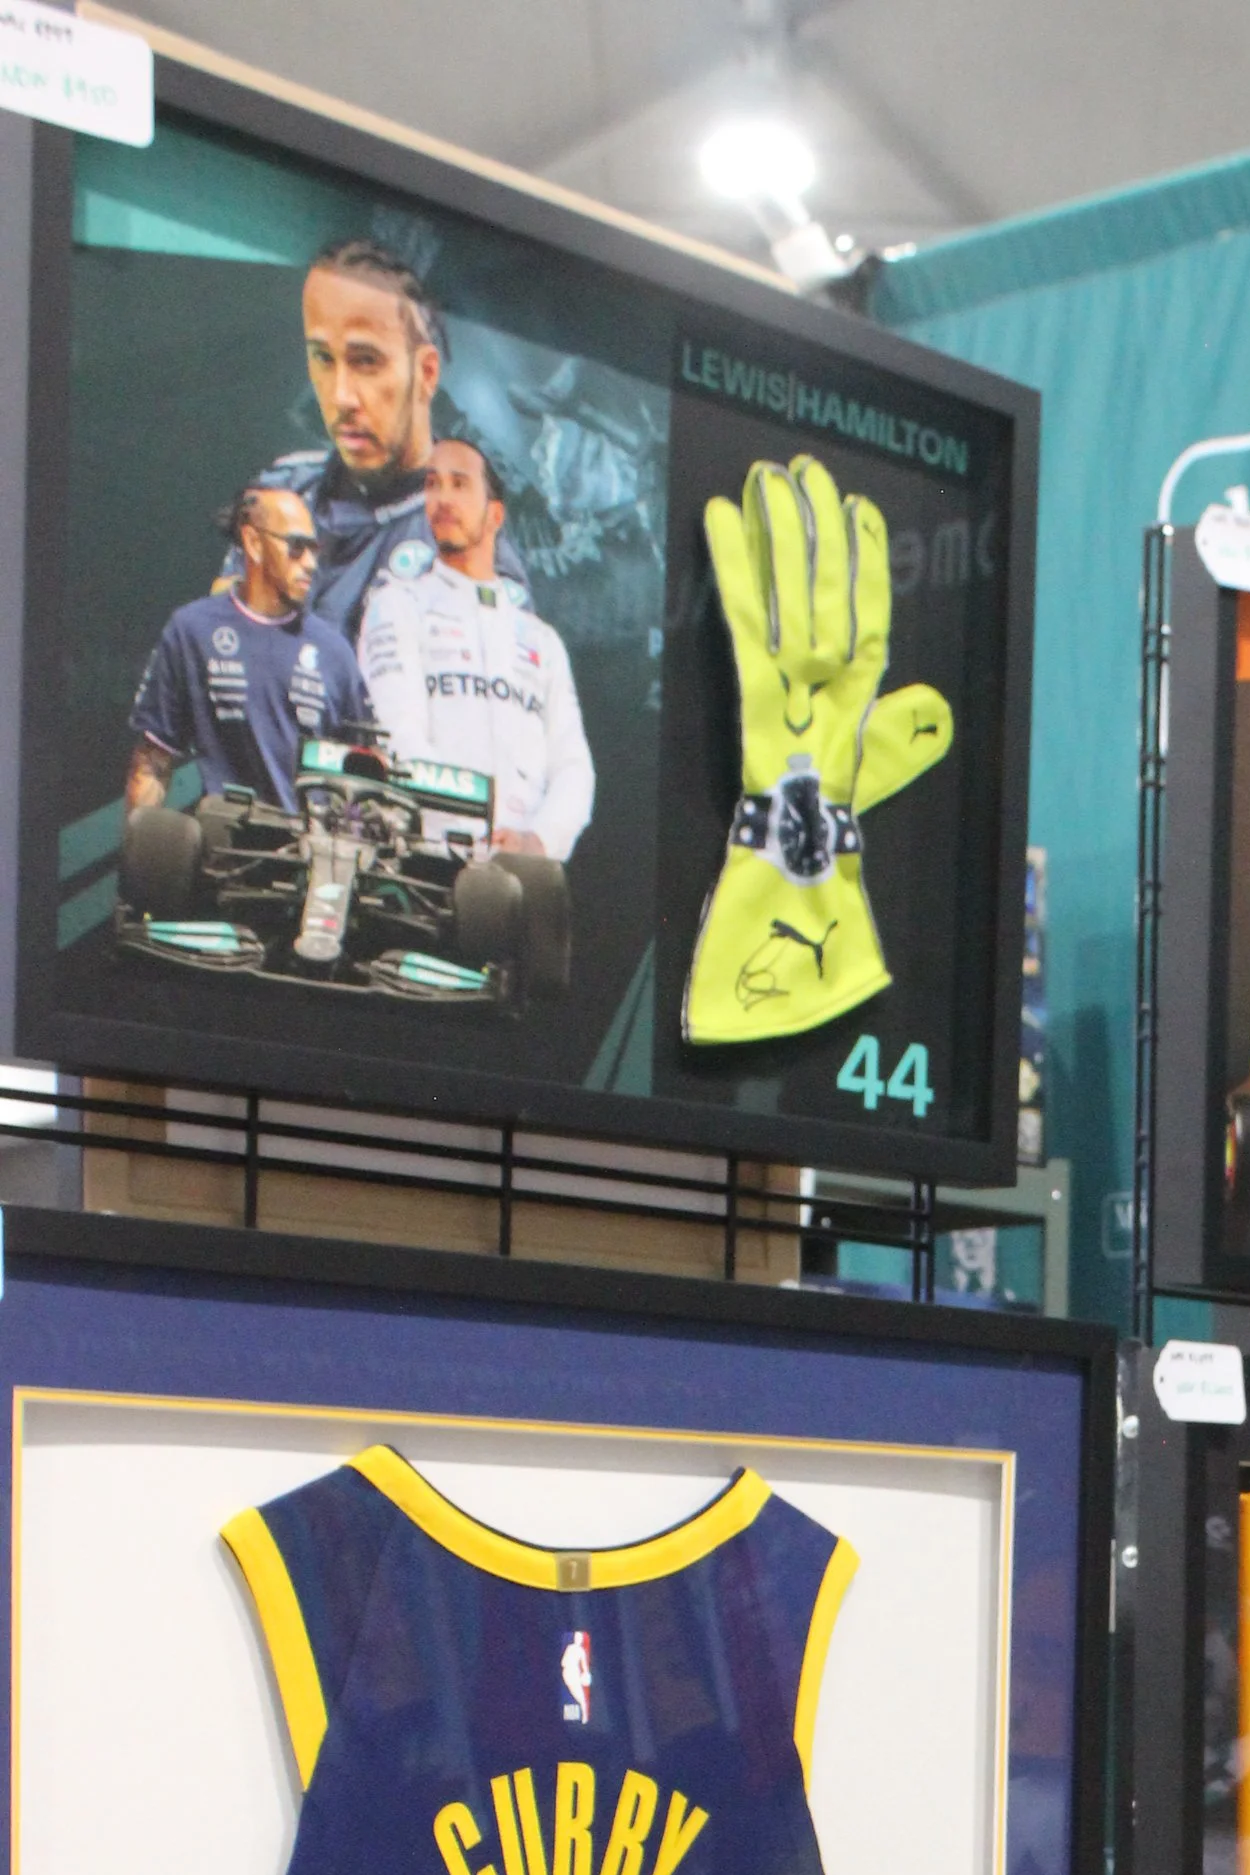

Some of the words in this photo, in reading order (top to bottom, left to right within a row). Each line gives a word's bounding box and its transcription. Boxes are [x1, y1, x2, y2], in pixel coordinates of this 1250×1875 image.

[797, 383, 969, 475] HAMILTON
[425, 672, 543, 714] PETRONA
[836, 1034, 935, 1118] 44
